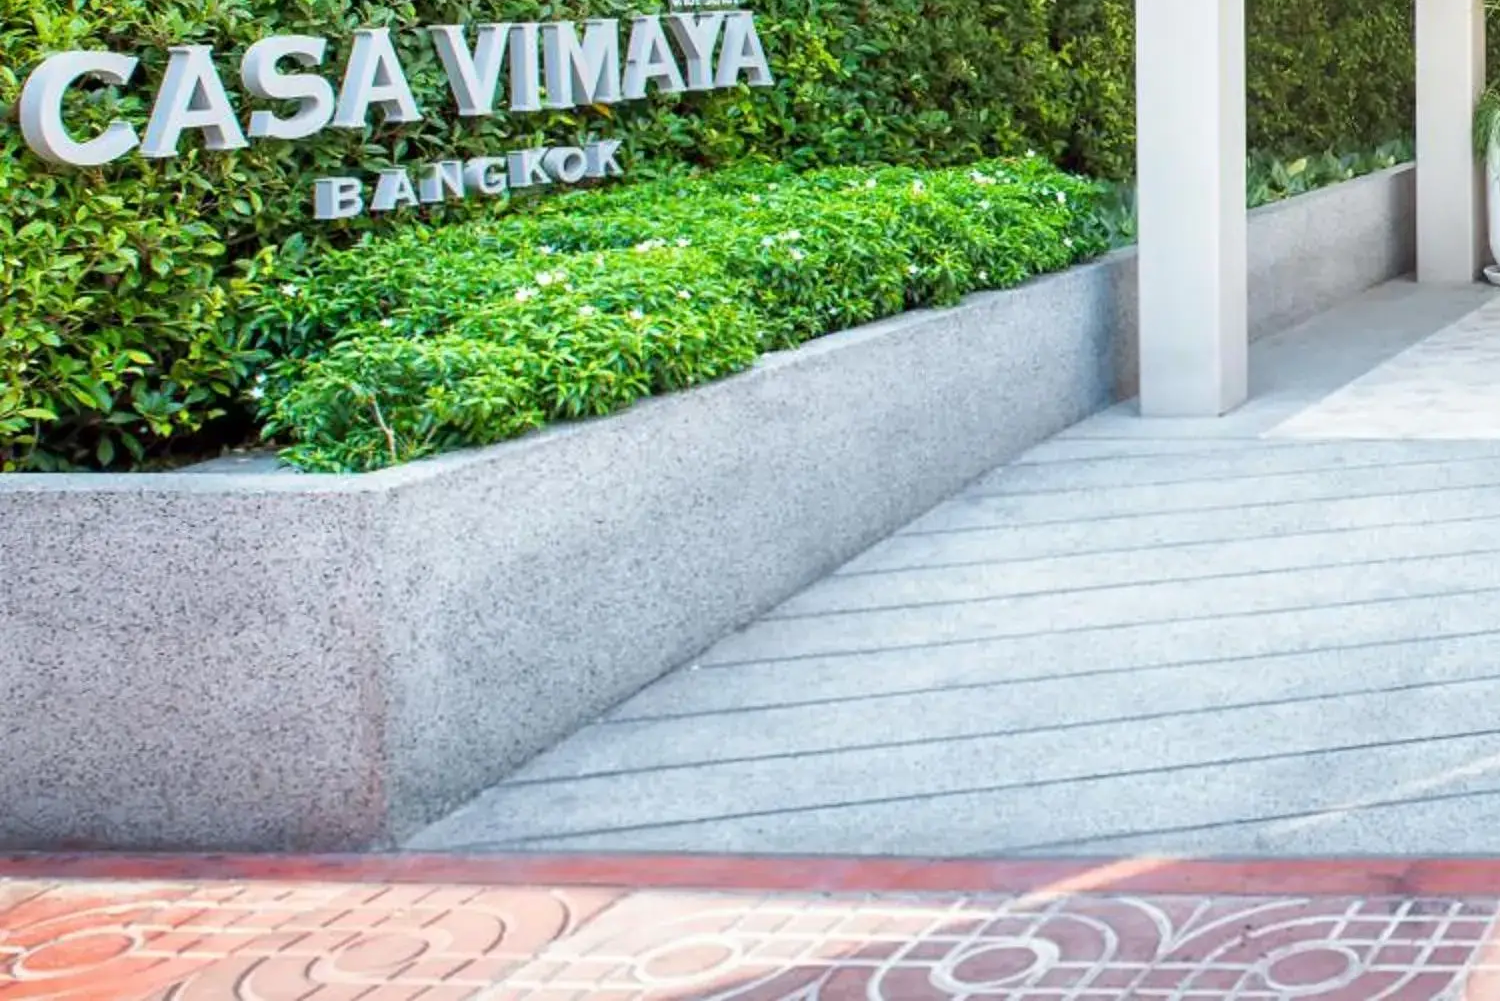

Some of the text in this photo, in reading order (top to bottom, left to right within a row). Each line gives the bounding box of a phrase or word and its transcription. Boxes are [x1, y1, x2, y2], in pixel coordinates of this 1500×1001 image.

[19, 9, 775, 166] CASA VIMAYA
[313, 138, 625, 220] BANGKOK
